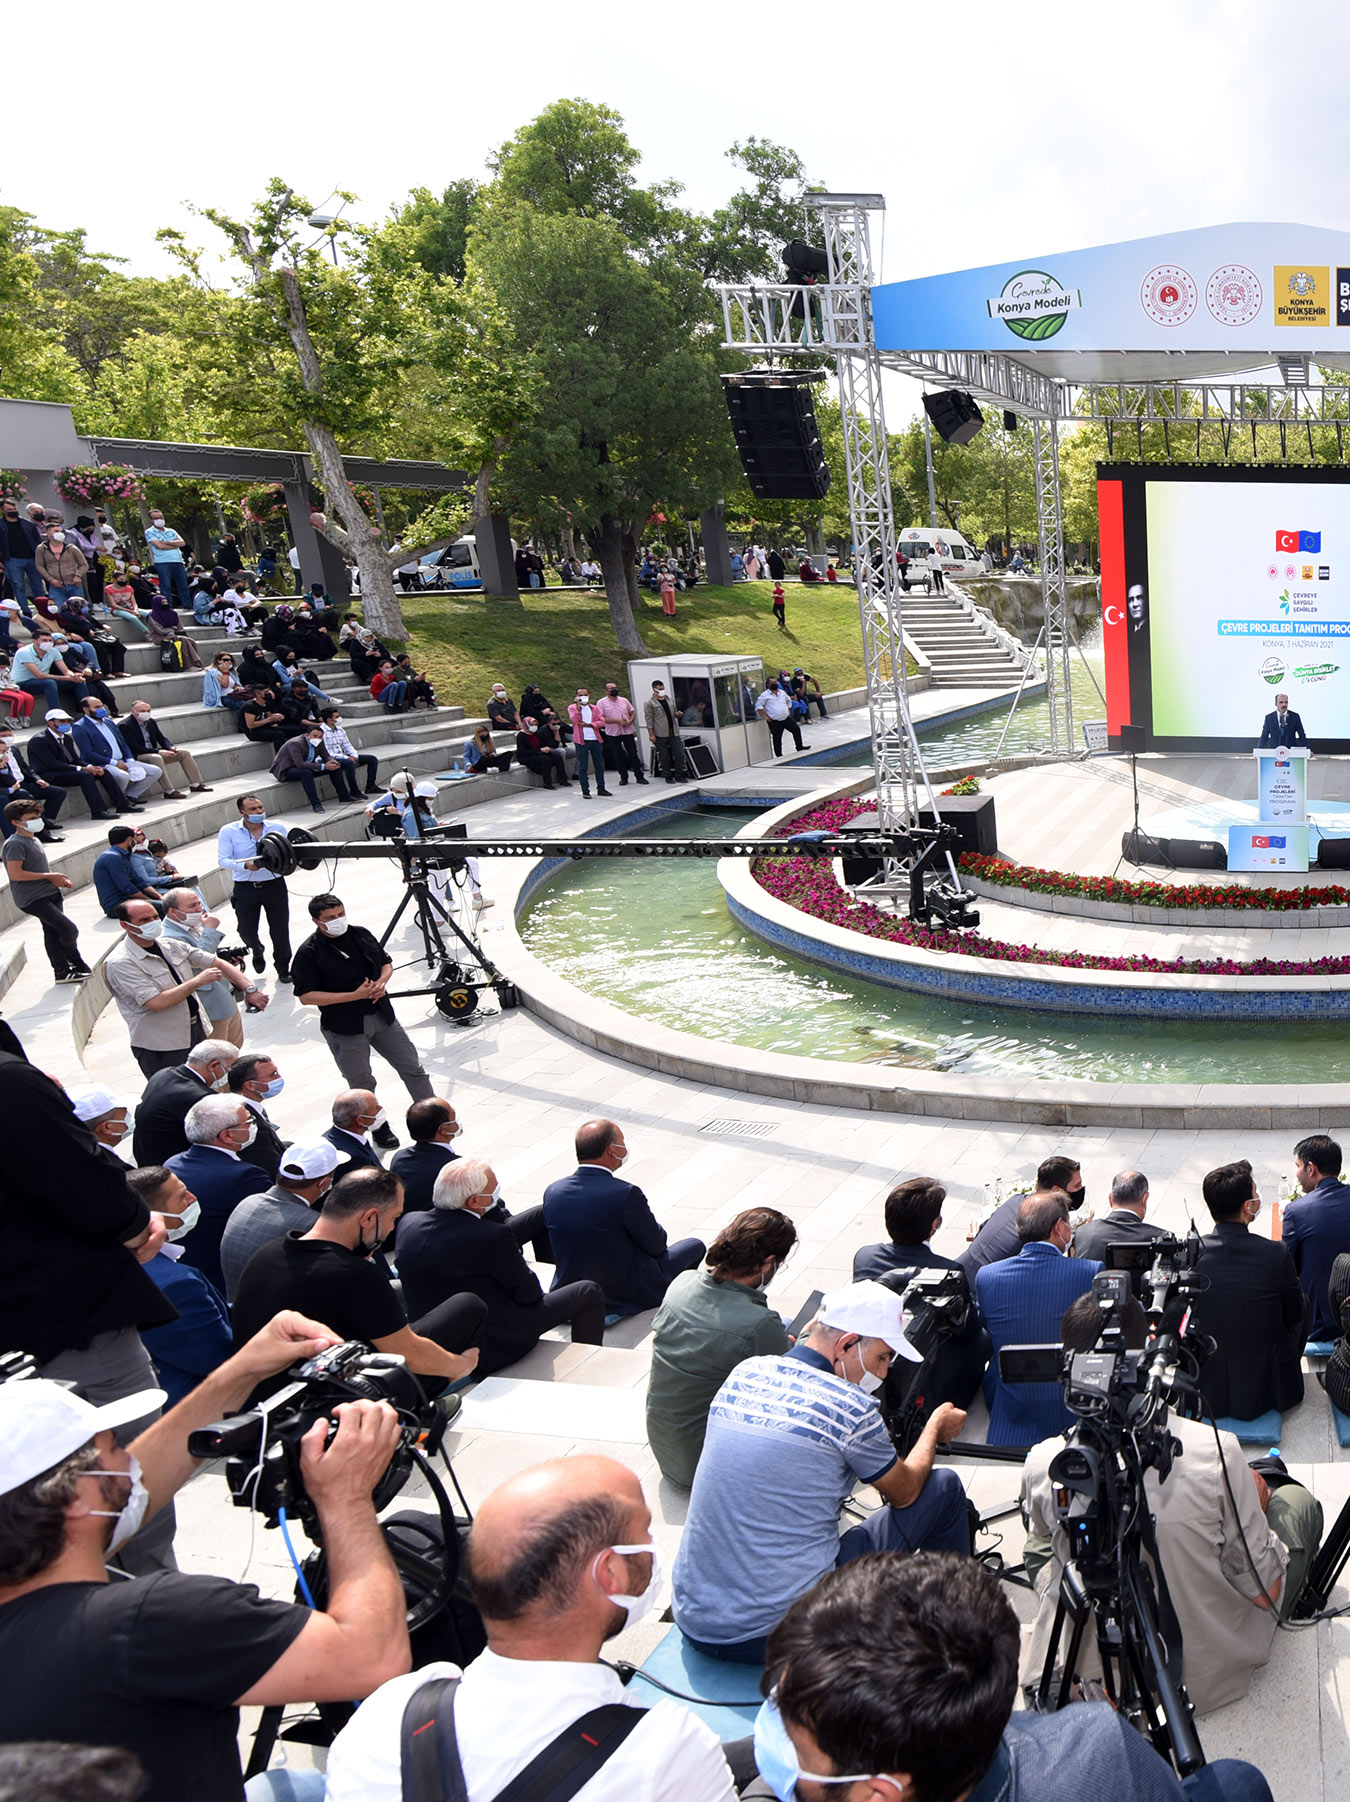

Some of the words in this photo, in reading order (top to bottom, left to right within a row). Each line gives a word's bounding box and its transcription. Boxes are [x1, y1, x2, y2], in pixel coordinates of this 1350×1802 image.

[997, 302, 1031, 314] Konya
[1034, 295, 1071, 310] Modeli
[1278, 306, 1326, 316] BÜYÜKŞEHİR
[449, 568, 472, 580] POLİS
[1293, 592, 1317, 600] ÇEVREYE
[1293, 606, 1318, 614] ŞEHİRLER
[1221, 623, 1248, 635] ÇEVRE
[1250, 621, 1293, 633] PROJELERİ
[1295, 624, 1328, 634] TANITIM
[1262, 640, 1286, 649] KONYA,
[1286, 640, 1291, 648] 3
[1291, 639, 1319, 648] HAZİRAN
[1320, 641, 1334, 649] 2021
